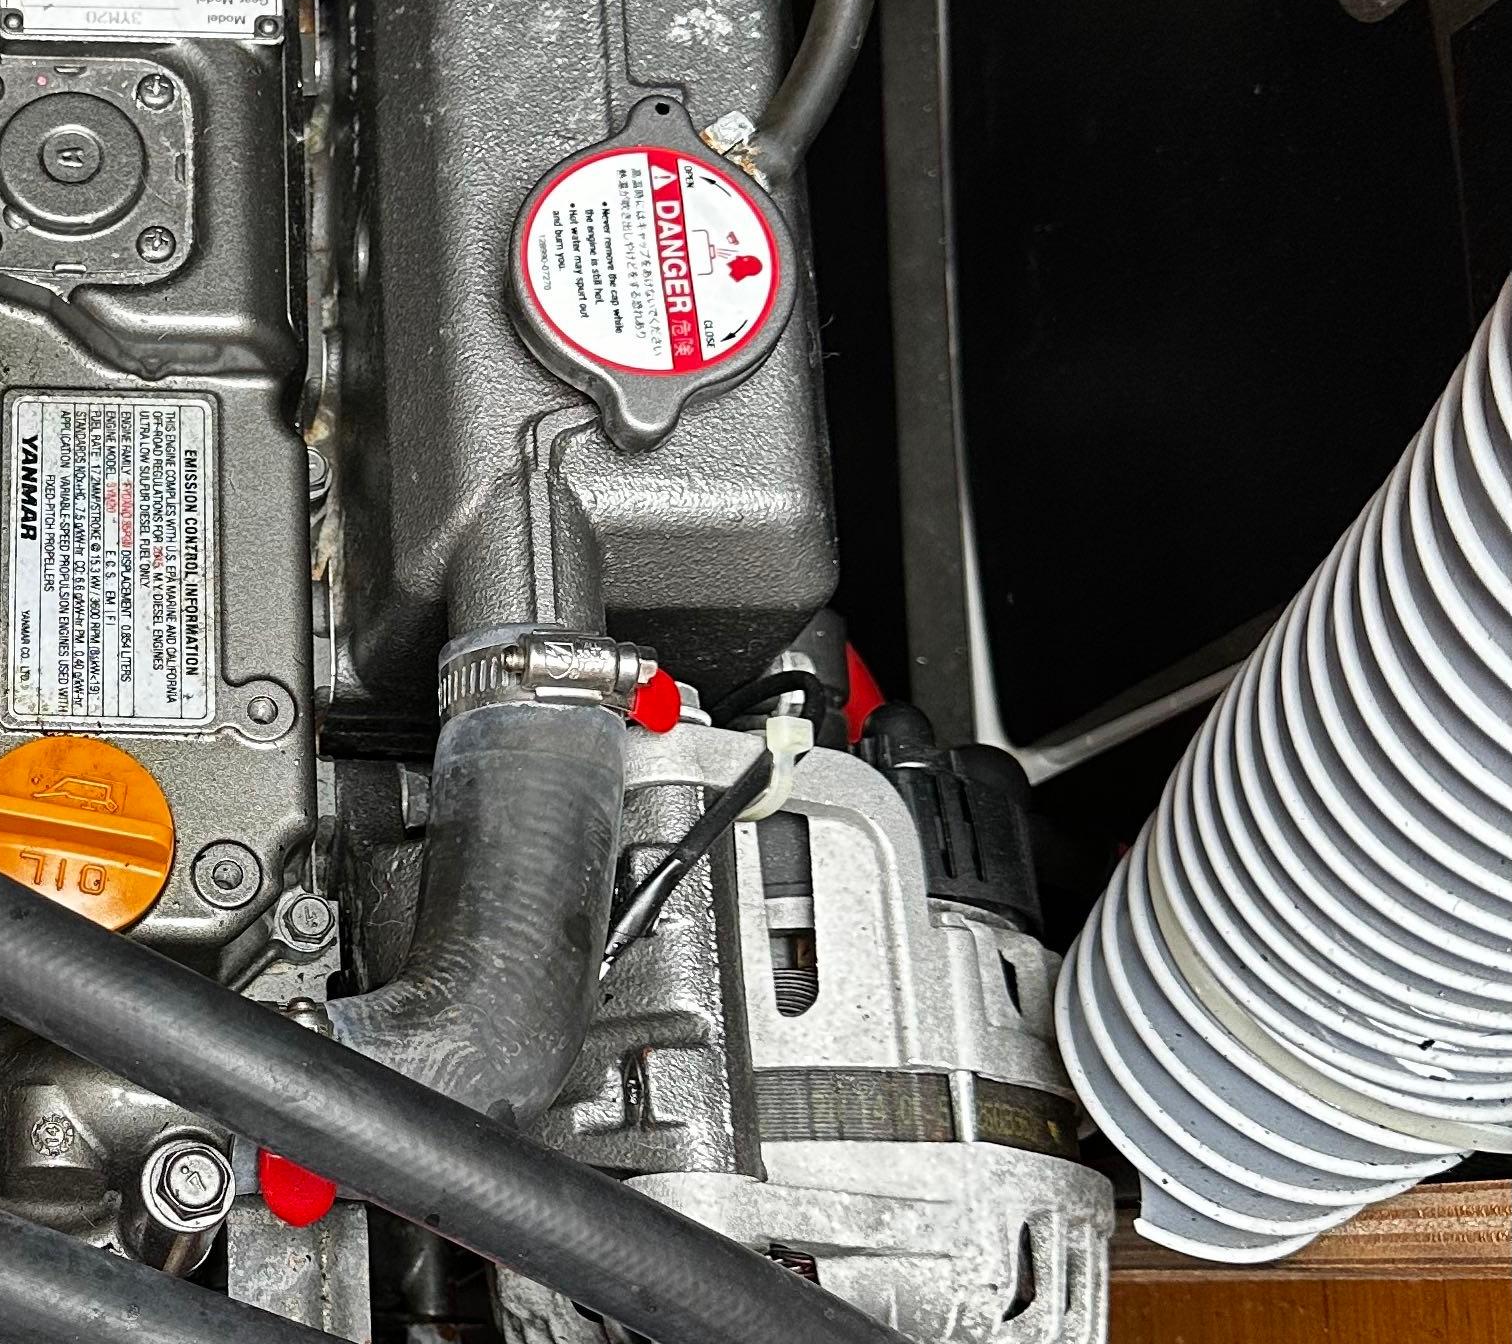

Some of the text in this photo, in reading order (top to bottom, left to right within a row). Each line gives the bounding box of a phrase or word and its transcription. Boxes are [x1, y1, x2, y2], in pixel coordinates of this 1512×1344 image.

[86, 11, 246, 25] Model 3YM20
[684, 166, 695, 189] OPEN
[553, 210, 563, 226] and
[585, 209, 595, 223] the
[555, 230, 565, 250] burn
[585, 226, 598, 255] engine
[568, 210, 589, 318] Hot water may spurt out
[602, 208, 623, 334] Never remove the cap while
[655, 200, 693, 313] DANGER
[592, 269, 603, 286] still
[672, 319, 694, 357] 危険
[703, 320, 716, 349] CLOSE
[75, 411, 86, 463] STANDARDS
[91, 411, 101, 432] FUEL
[106, 411, 116, 442] ENGINE
[91, 435, 101, 456] RATE
[106, 446, 116, 476] MODEL
[140, 411, 149, 560] ULTRA LOW SULFUR DIESEL FUEL
[20, 434, 39, 644] YANMAR YANMAR
[44, 474, 55, 592] FIXED-PITCH PROPELLERS
[121, 412, 131, 682] ENGINE FAMILY DISPLACEMENT 0.854 LITERS
[153, 411, 163, 670] OFF-ROAD REGULATIONS FOR DIESEL ENGINES
[58, 411, 71, 713] APPLICATION VARIABLE-SPEED PROPULSION ENGINES USED WITH
[165, 411, 177, 703] THIS ENGINE COMPLIES WITH U.S. EPA MARINE AND CALIFORNIA
[185, 450, 199, 676] EMISSION CONTROL INFORMATION
[91, 598, 100, 619] 3600
[106, 591, 116, 605] EM
[90, 622, 100, 643] RPM
[19, 851, 107, 896] OIL
